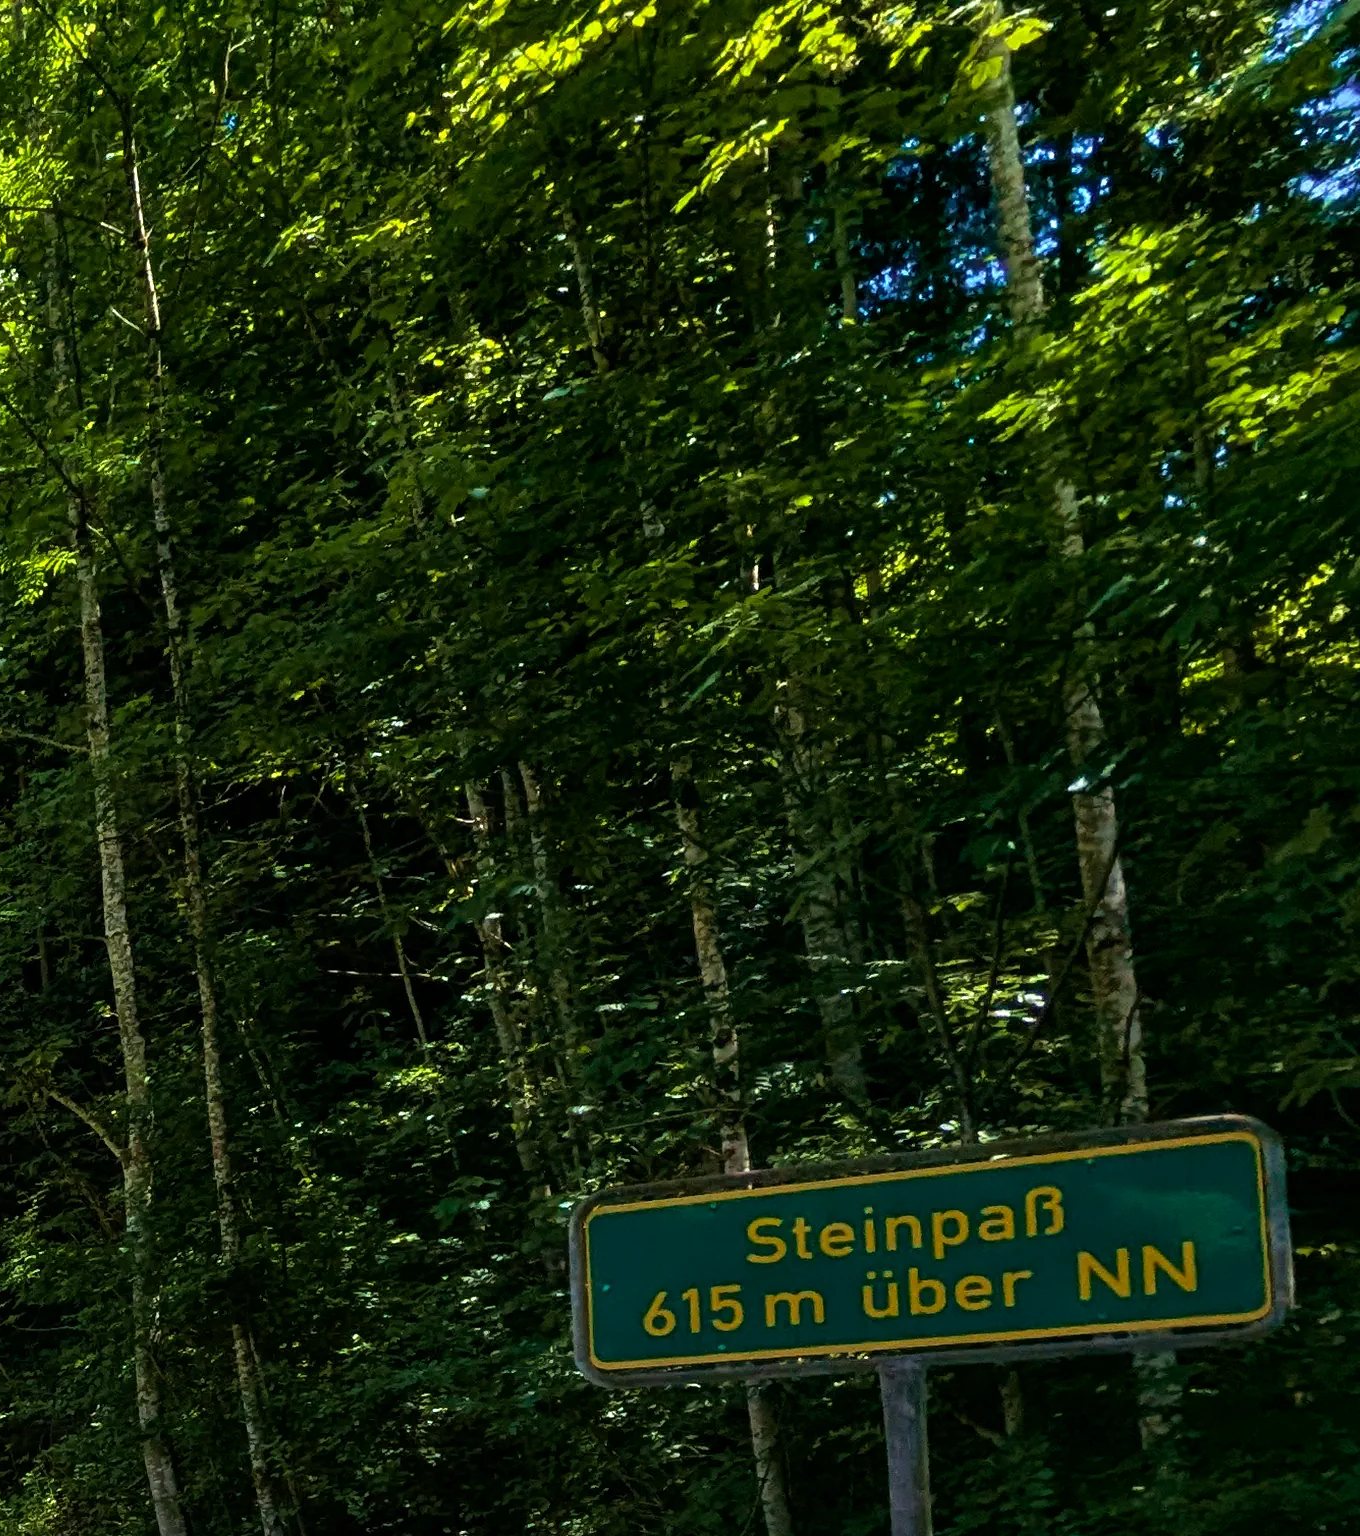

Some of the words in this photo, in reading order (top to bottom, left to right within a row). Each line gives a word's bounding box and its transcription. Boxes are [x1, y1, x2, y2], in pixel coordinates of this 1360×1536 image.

[745, 1184, 1066, 1266] Steinpaß
[642, 1283, 745, 1338] 615
[764, 1287, 827, 1327] m
[860, 1265, 1033, 1320] über
[1077, 1239, 1199, 1302] NN
